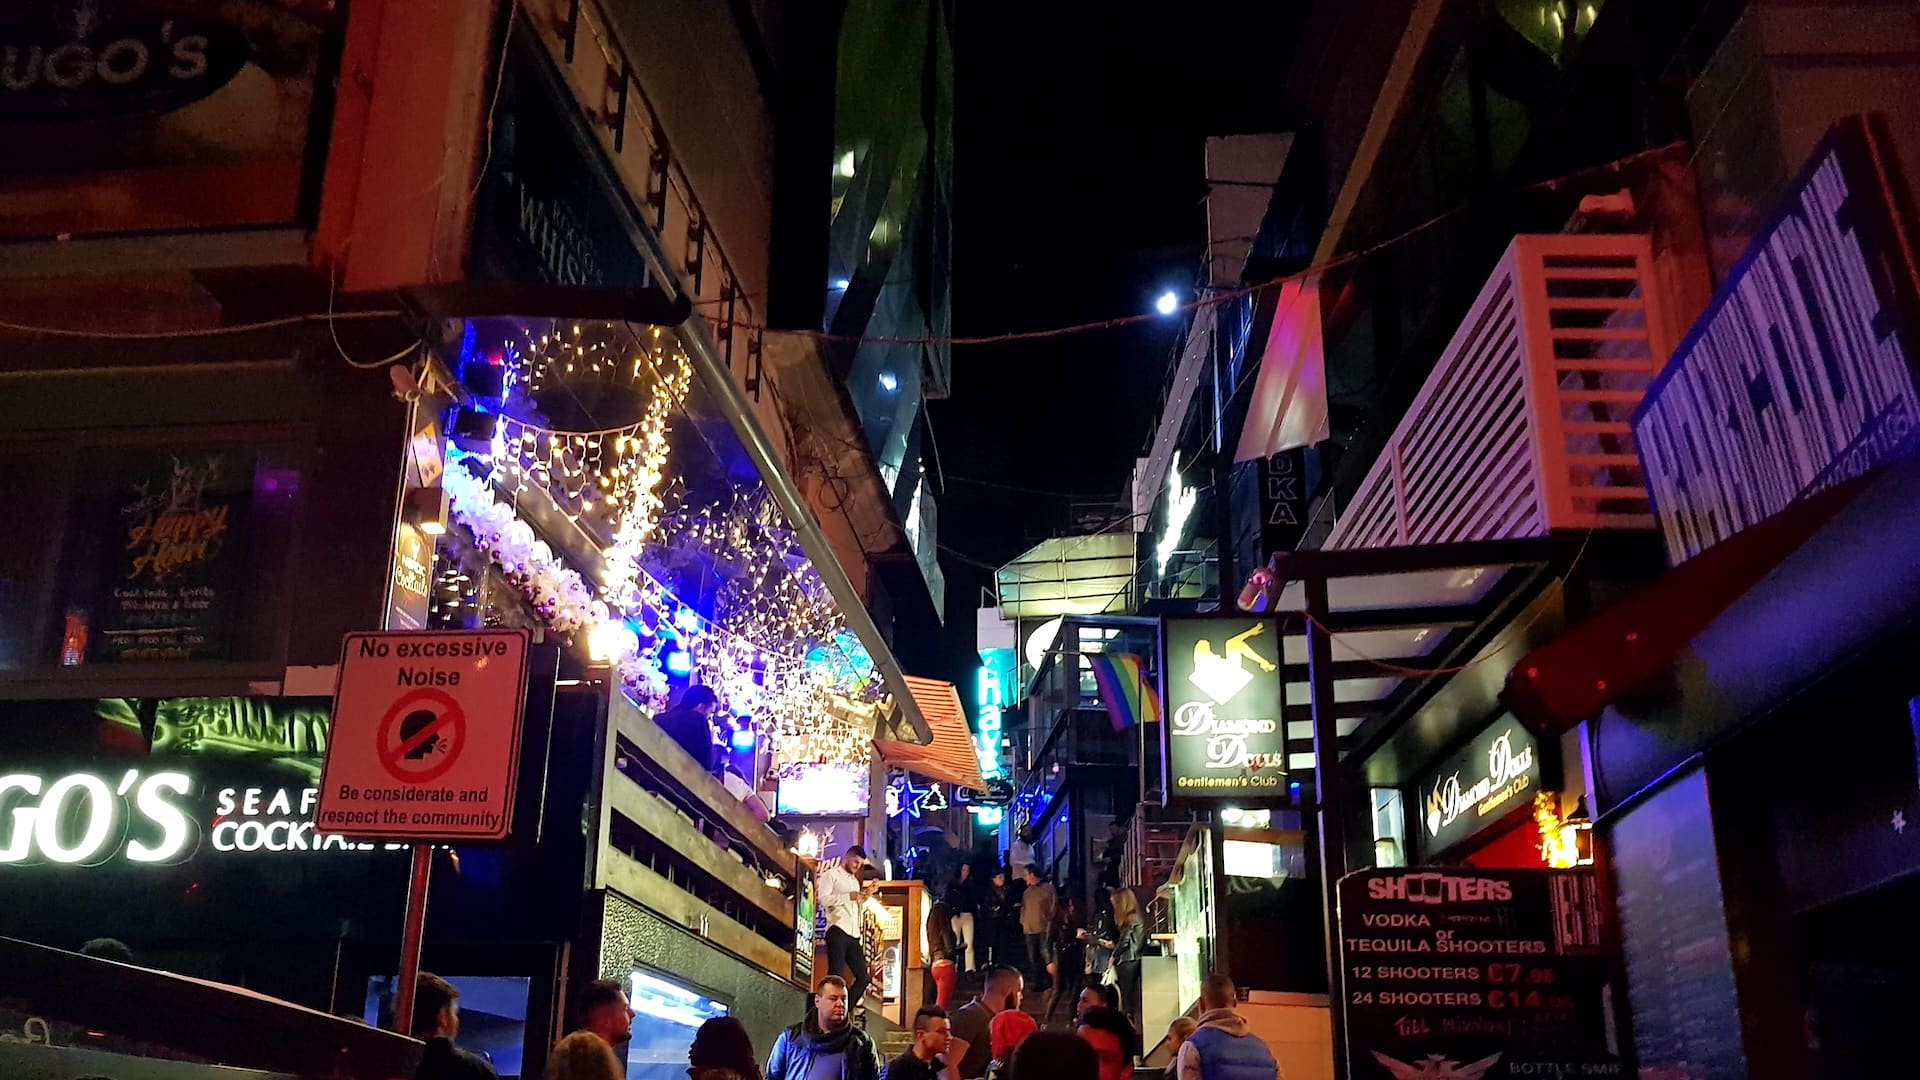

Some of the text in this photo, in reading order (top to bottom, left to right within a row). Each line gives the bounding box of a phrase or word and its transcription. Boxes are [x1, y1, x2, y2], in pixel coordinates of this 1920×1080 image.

[359, 637, 507, 658] No excessive
[397, 667, 460, 686] Noise
[1250, 775, 1278, 787] Club
[339, 785, 489, 802] Be considerate and
[321, 808, 499, 830] respect the community
[1362, 913, 1431, 928] VODKA
[1436, 929, 1455, 941] or
[1346, 938, 1547, 954] TEQUILA SHOOTERS
[1352, 967, 1373, 980] 12
[1377, 966, 1480, 981] SHOOTERS
[1352, 992, 1373, 1005] 24
[1378, 992, 1482, 1007] SHOOTERS
